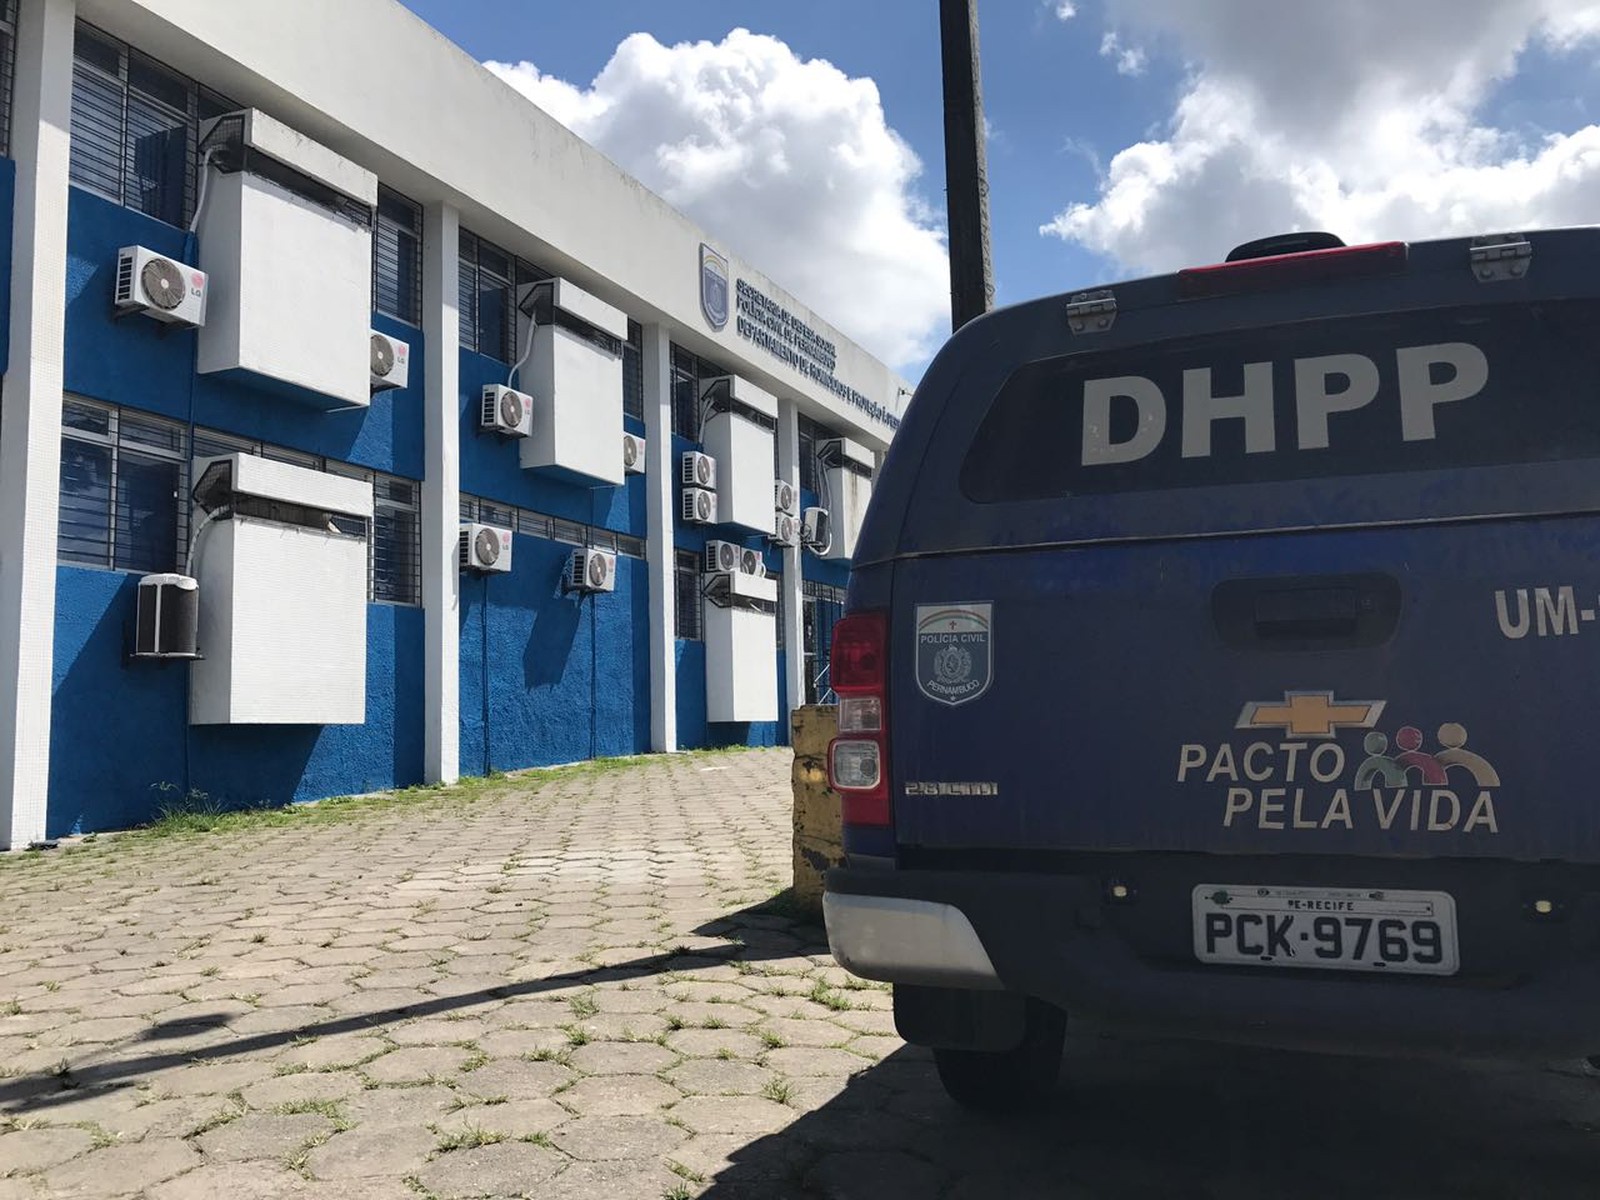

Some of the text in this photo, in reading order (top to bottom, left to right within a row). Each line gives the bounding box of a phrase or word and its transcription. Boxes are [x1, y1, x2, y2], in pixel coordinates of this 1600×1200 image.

[1080, 341, 1490, 467] DHPP
[1494, 585, 1600, 640] UM-
[920, 633, 986, 644] POLÍCIA CIVIL
[926, 679, 981, 695] PERNAMBUCO
[1177, 741, 1346, 784] PACTO
[1222, 786, 1500, 834] PELA VIDA
